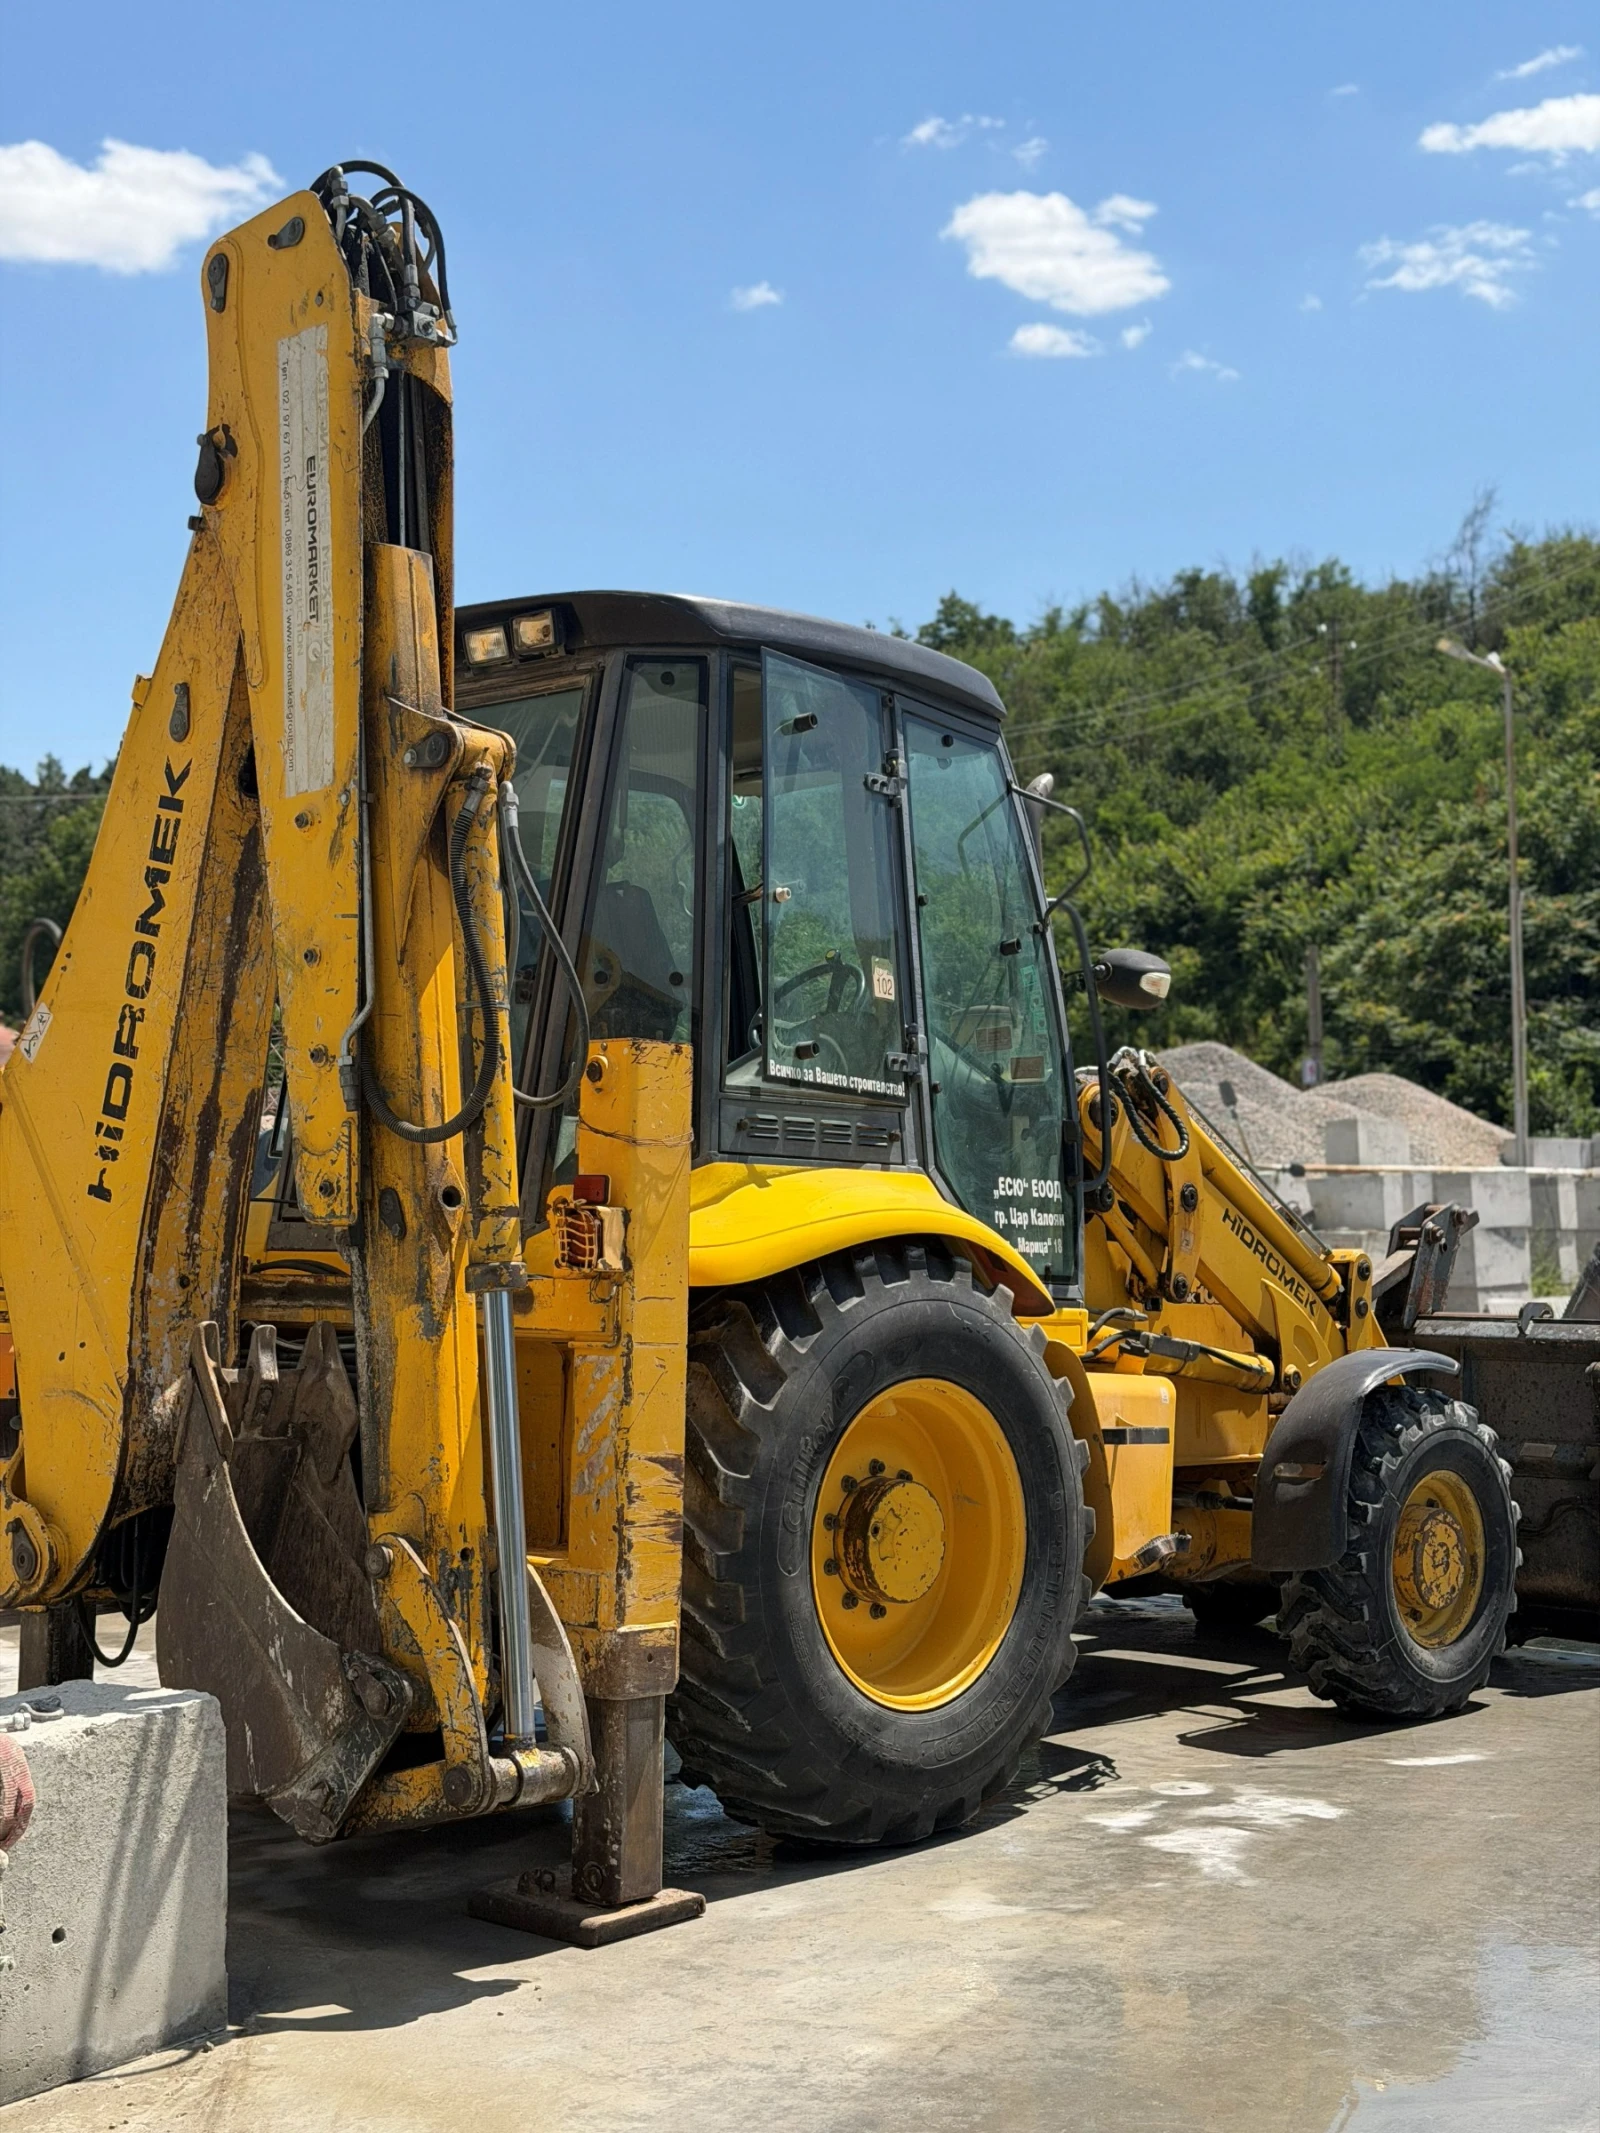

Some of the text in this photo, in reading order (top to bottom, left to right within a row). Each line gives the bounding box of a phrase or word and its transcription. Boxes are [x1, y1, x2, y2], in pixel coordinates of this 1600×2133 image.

[281, 390, 291, 405] 02
[282, 413, 291, 429] 97
[282, 431, 291, 446] 67
[284, 529, 293, 558] 0889
[306, 454, 319, 624] EUROMARKET
[285, 583, 294, 605] 490
[876, 977, 893, 996] 102
[769, 1059, 906, 1098] Всичко за Вашето строителство!
[1031, 1178, 1063, 1203] ЕООД
[994, 1206, 1066, 1230] гр. Цар Калоян
[1053, 1238, 1064, 1254] 18
